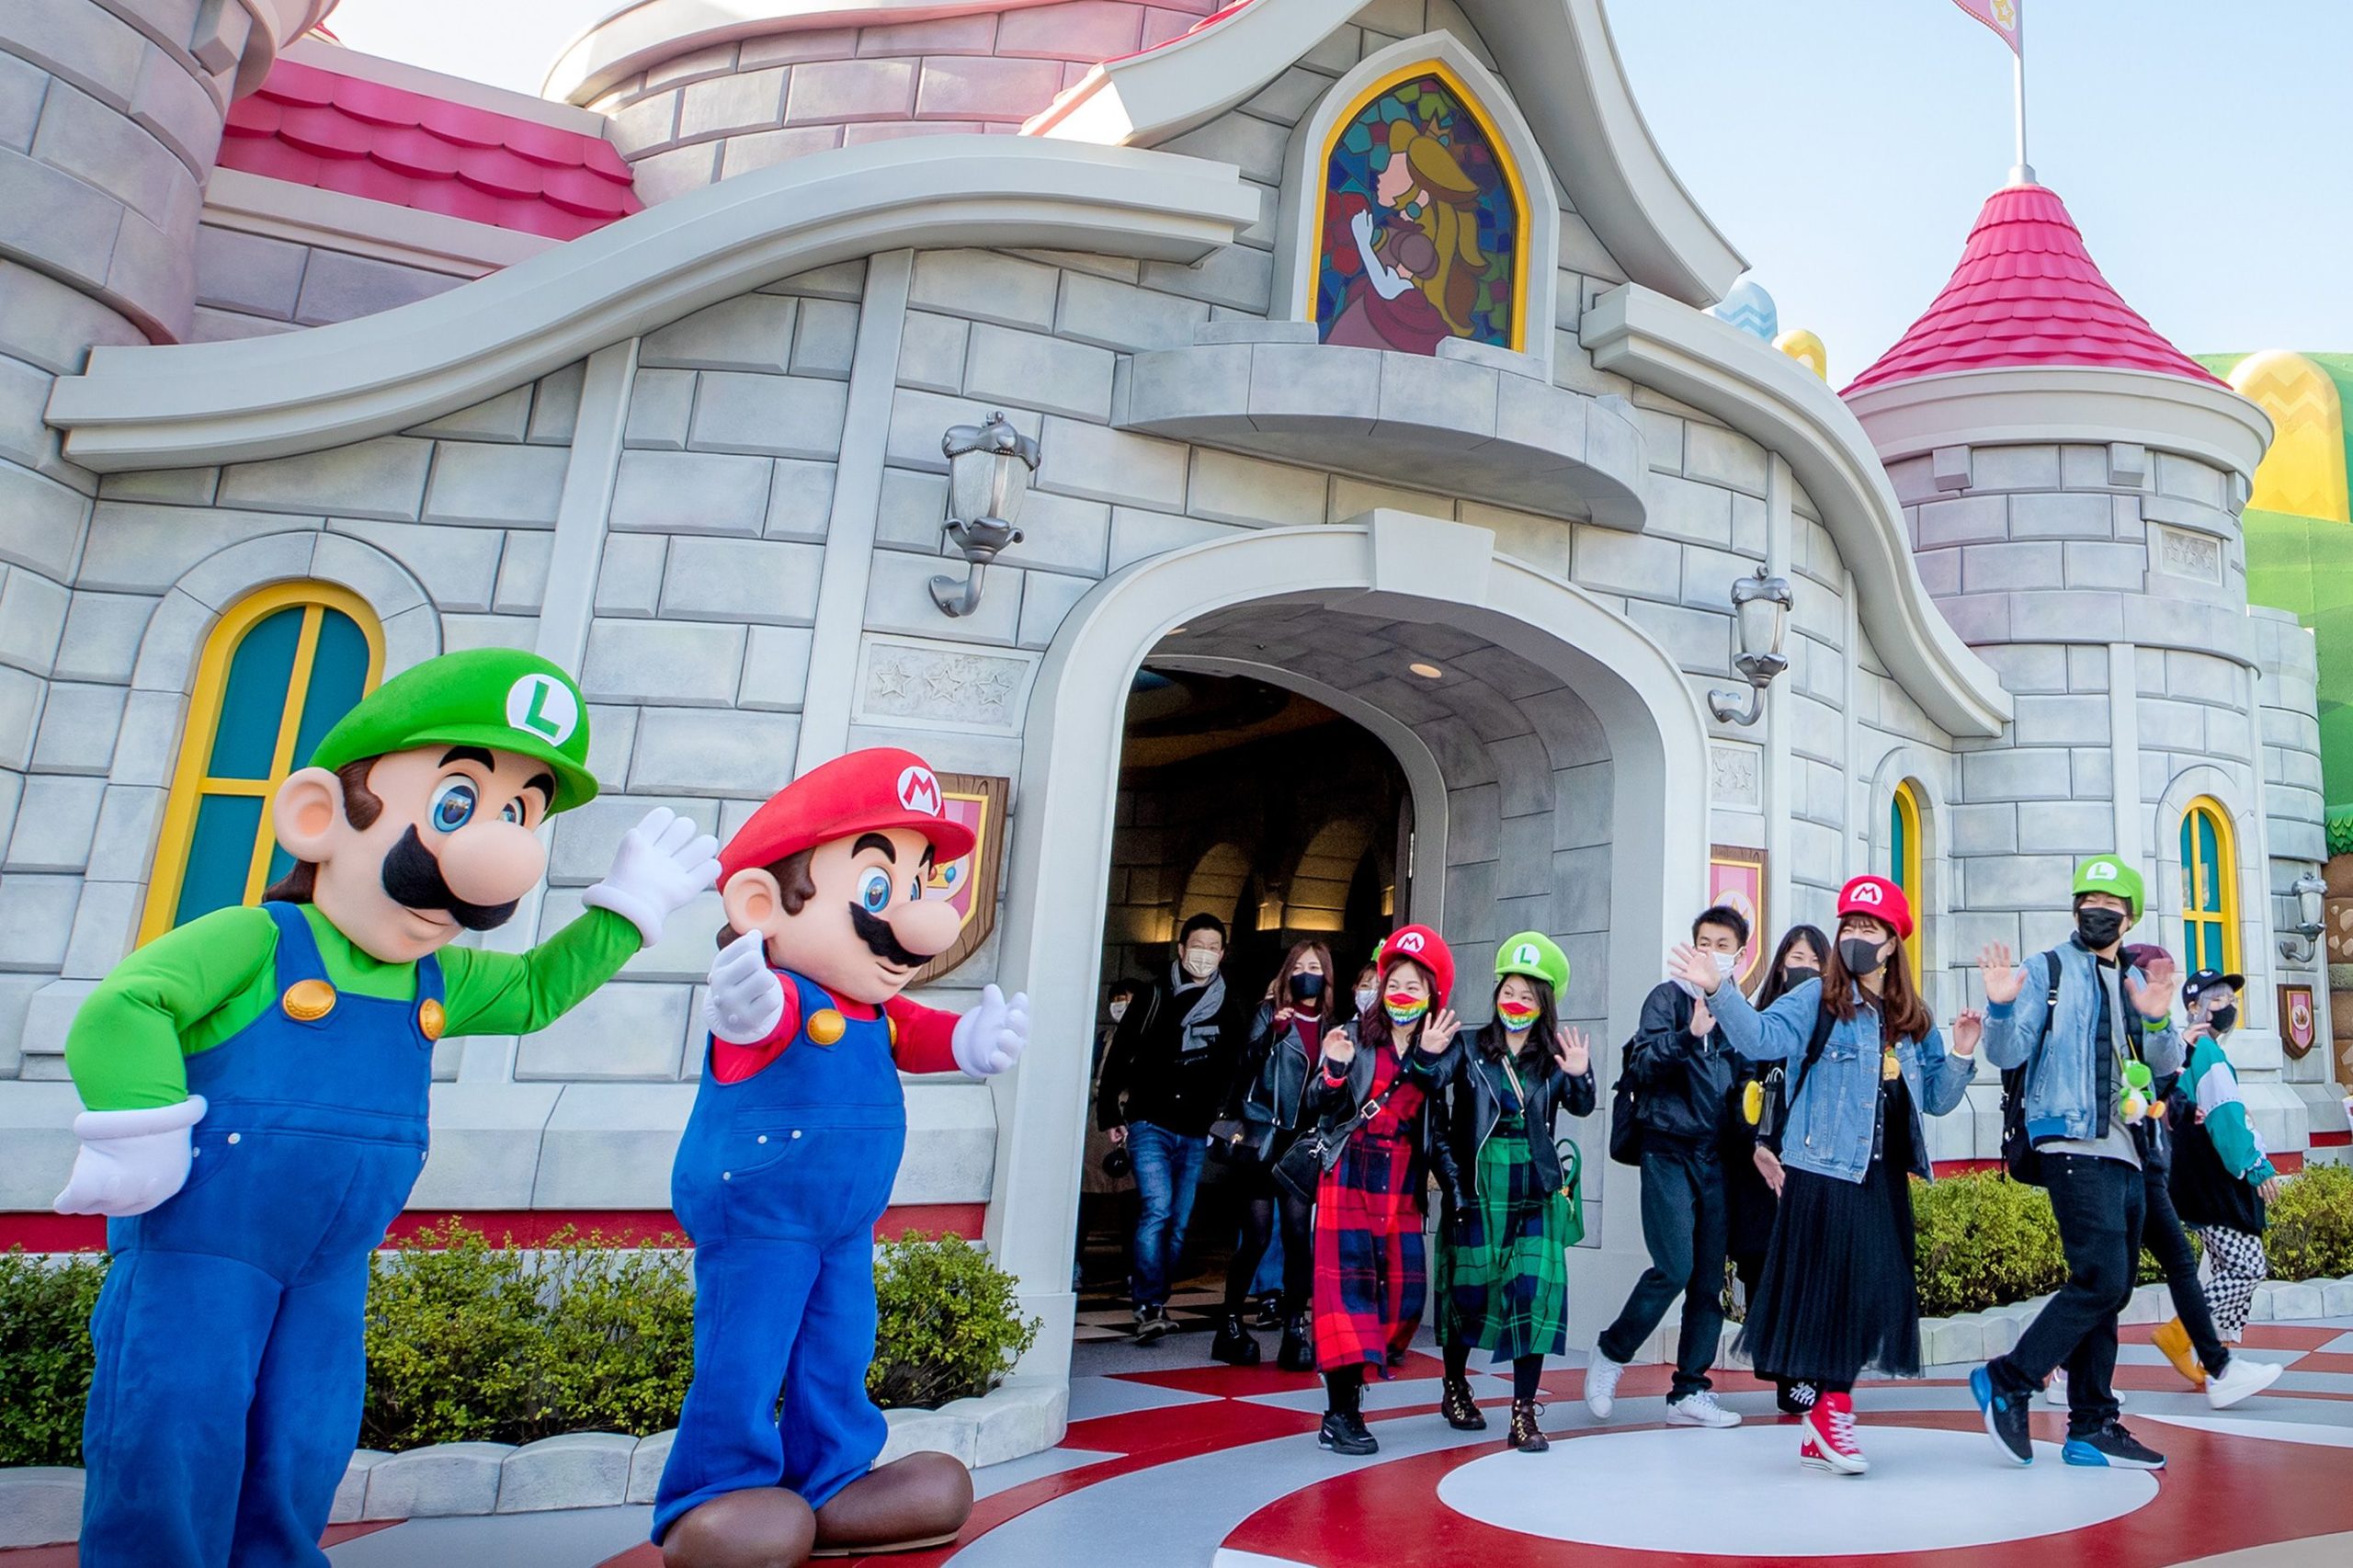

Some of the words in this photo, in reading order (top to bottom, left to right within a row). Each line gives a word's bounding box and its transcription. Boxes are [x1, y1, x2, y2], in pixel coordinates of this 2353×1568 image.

[525, 680, 561, 738] L
[904, 771, 938, 812] M
[2094, 864, 2108, 876] L
[1854, 887, 1878, 903] M
[1401, 937, 1420, 950] M
[1519, 947, 1532, 964] L
